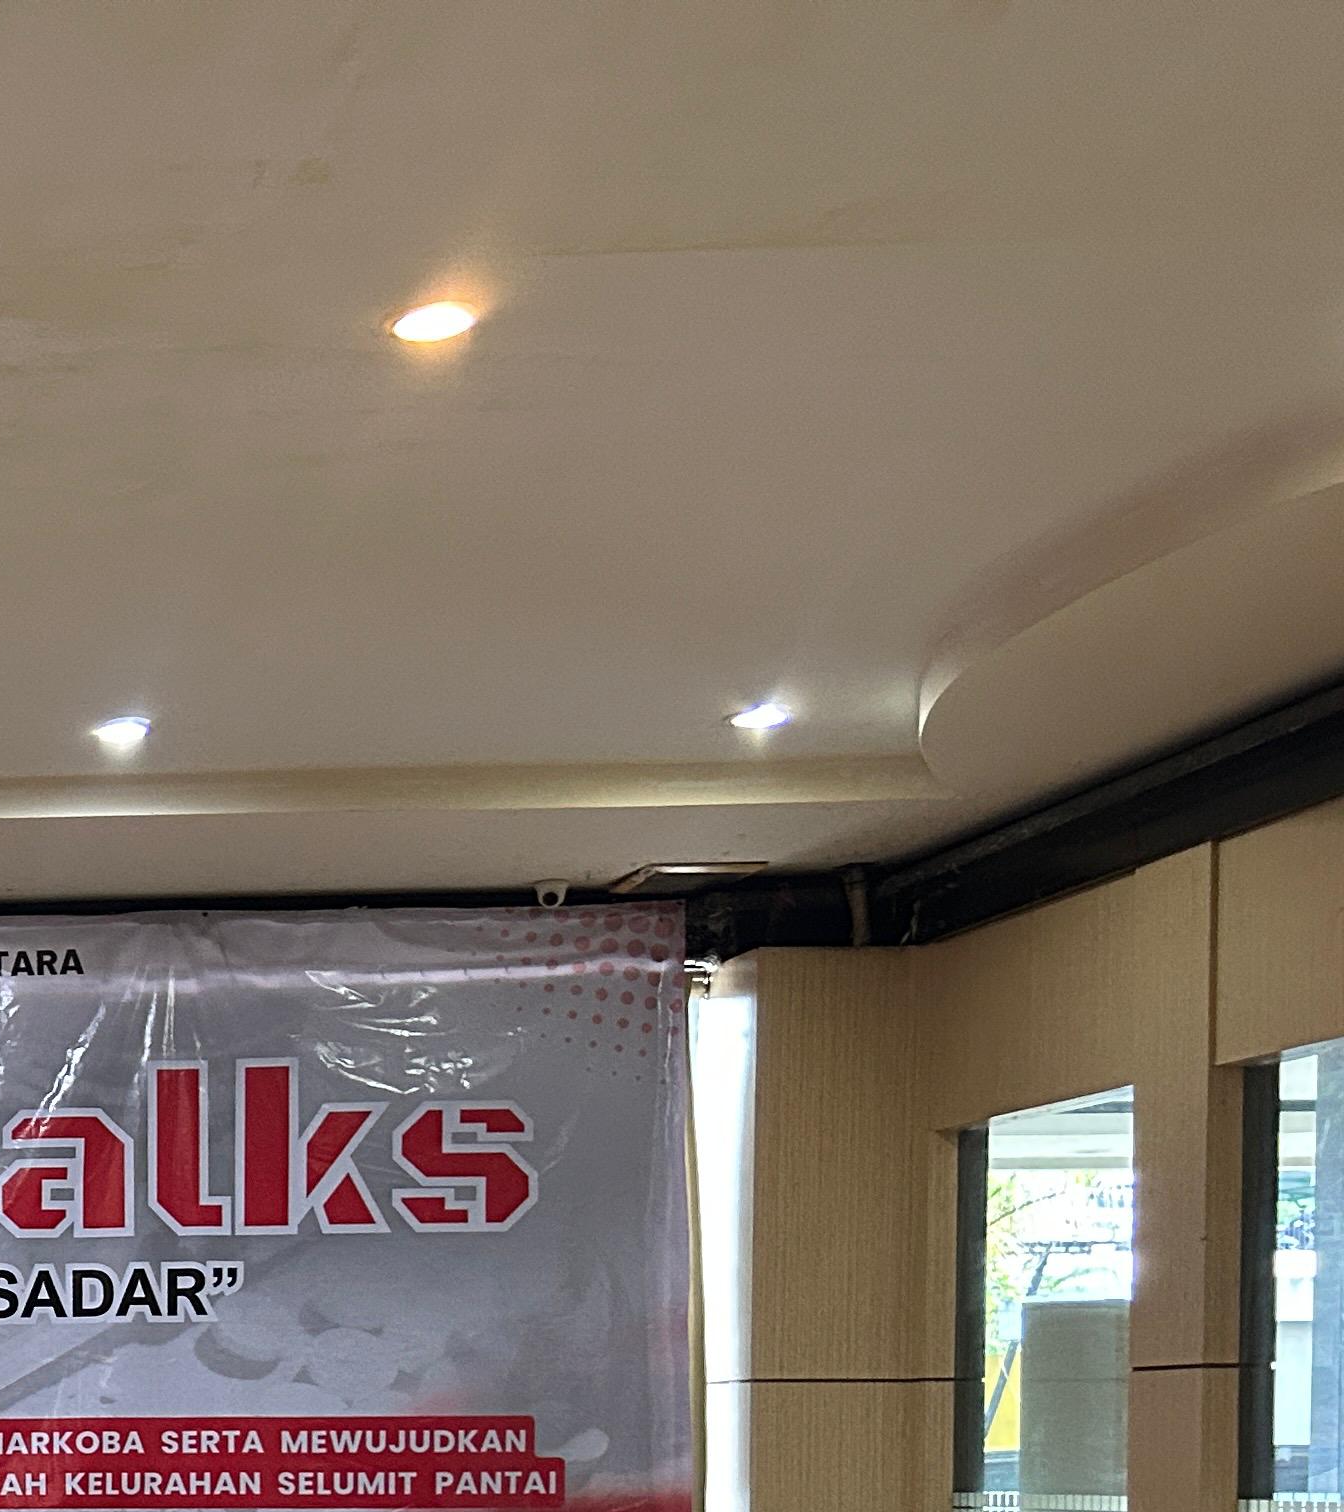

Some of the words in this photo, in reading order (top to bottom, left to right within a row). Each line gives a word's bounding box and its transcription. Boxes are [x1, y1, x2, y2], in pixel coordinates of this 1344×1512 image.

[160, 1430, 265, 1454] SERTA
[280, 1429, 527, 1454] MEWUJUDKAN
[64, 1472, 261, 1496] KELURAHAN
[277, 1471, 418, 1496] SELUMIT
[435, 1470, 557, 1495] PANTAI
